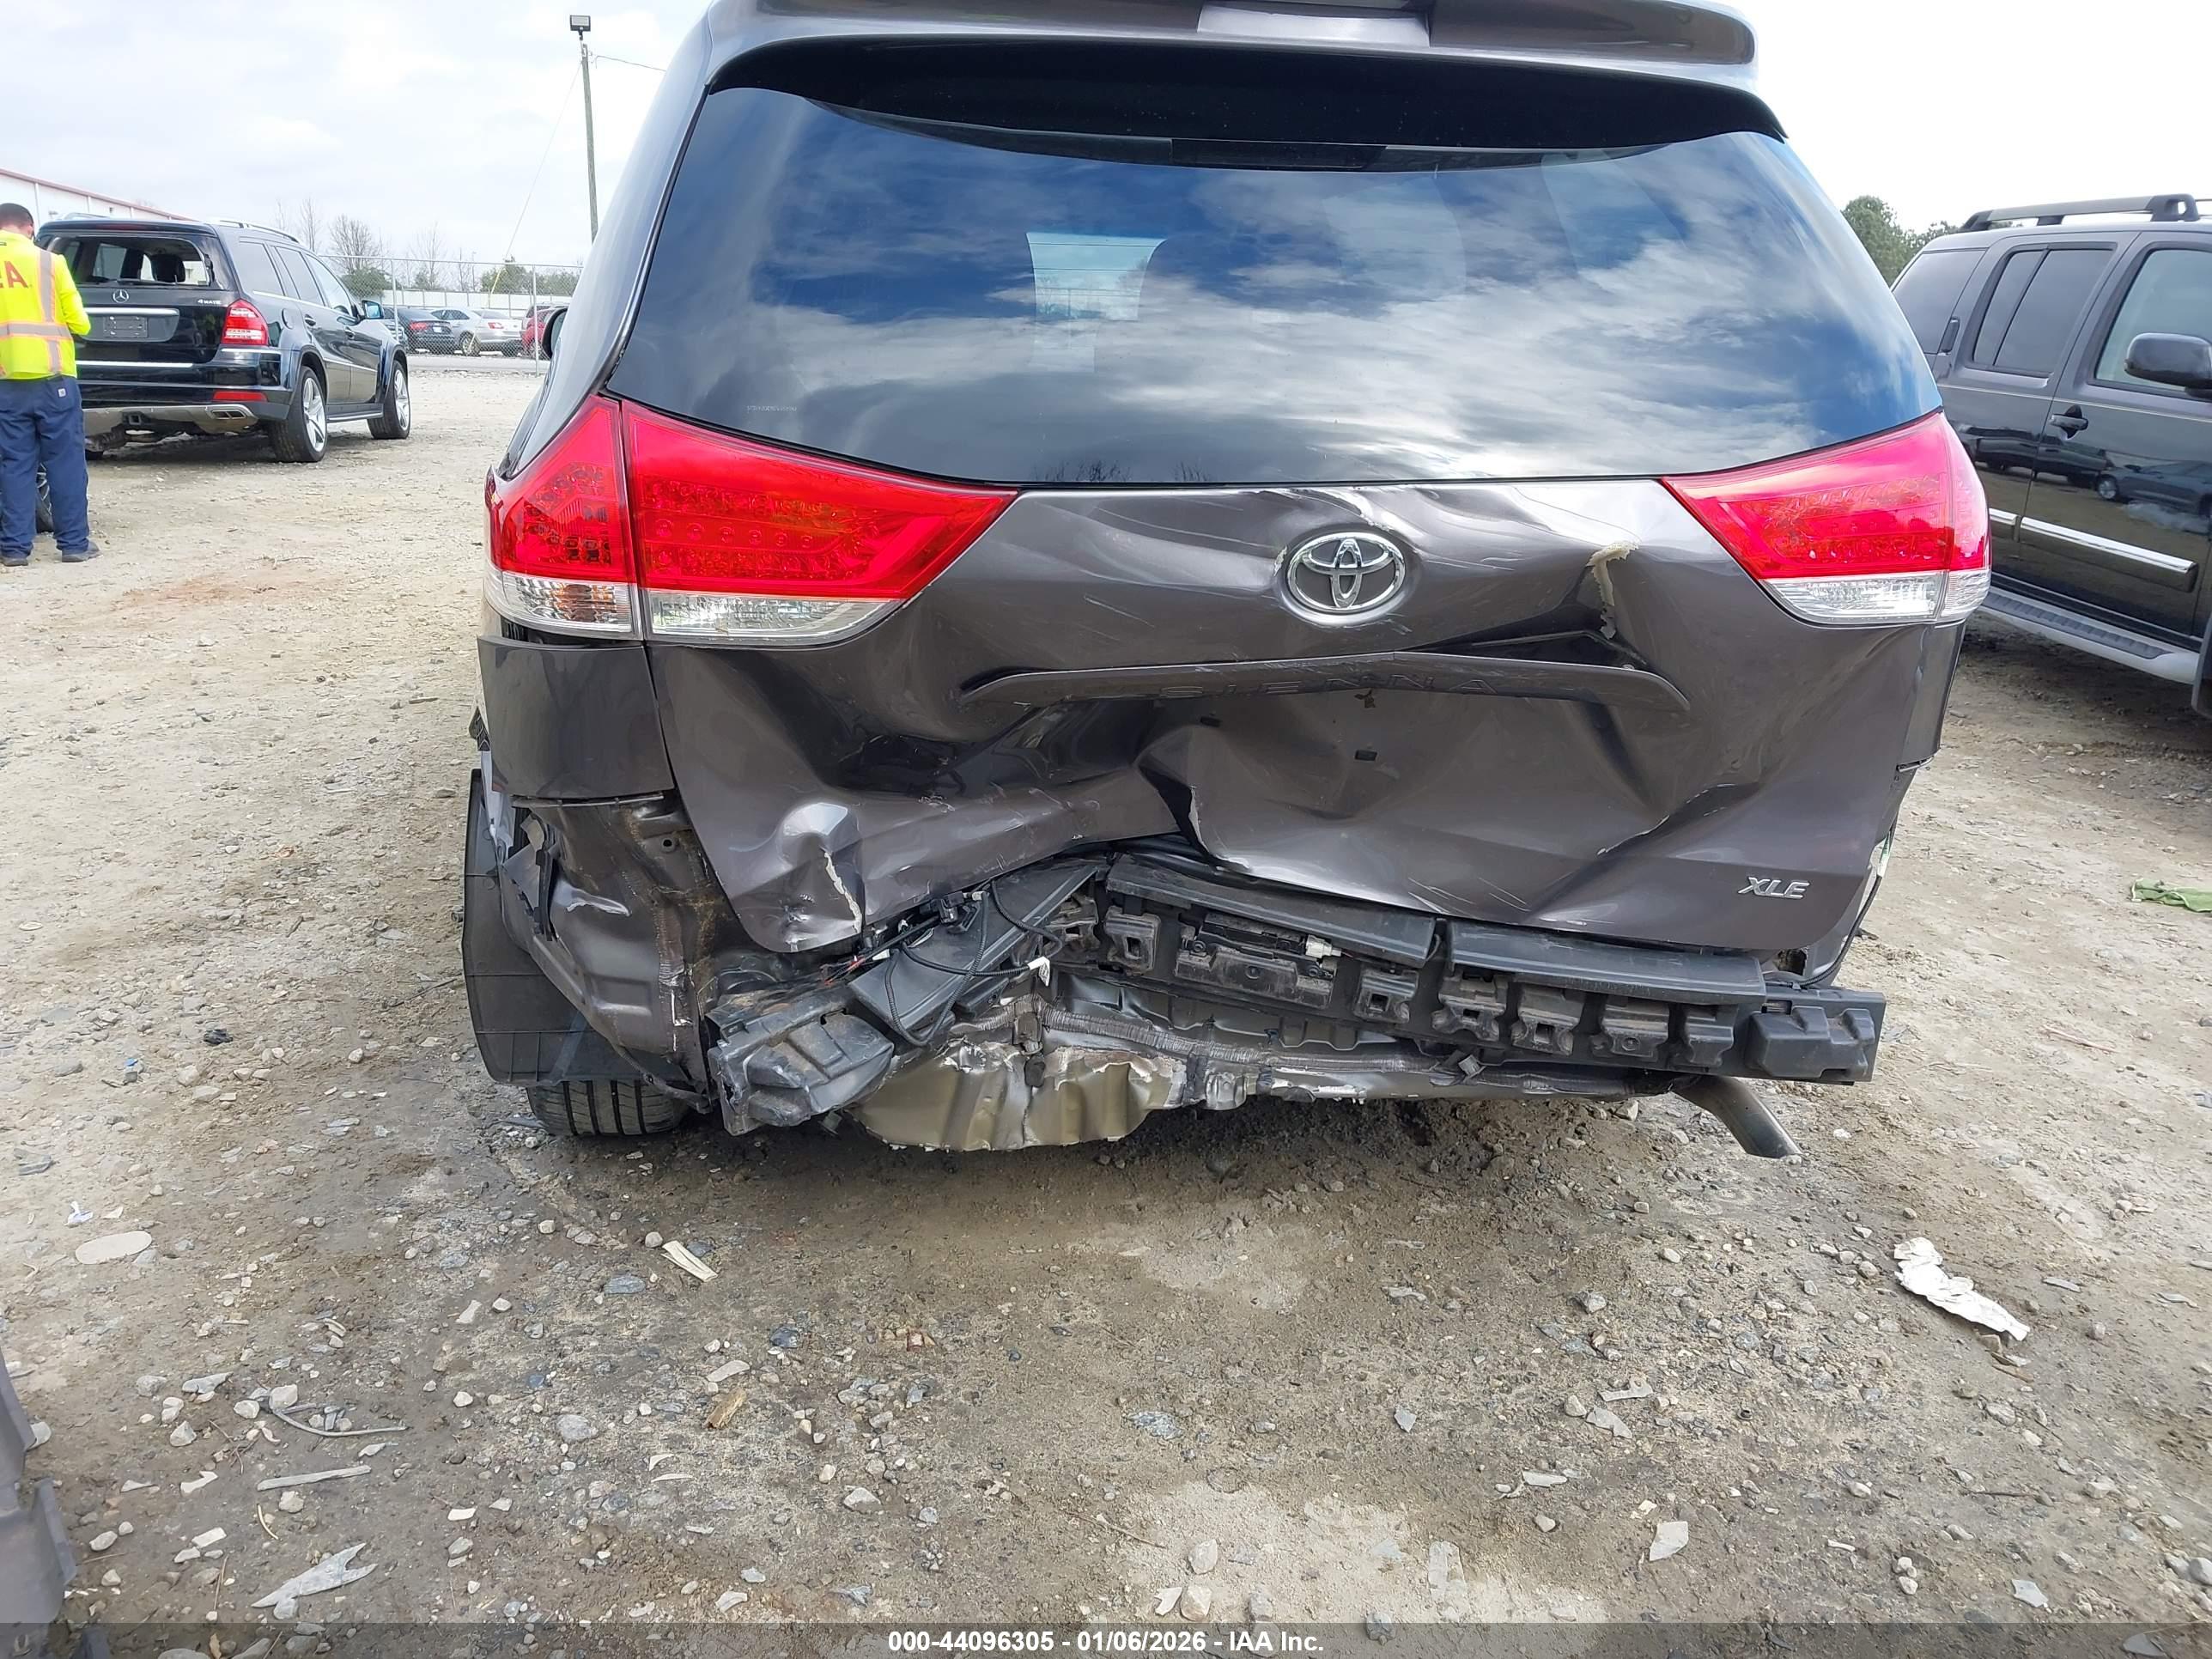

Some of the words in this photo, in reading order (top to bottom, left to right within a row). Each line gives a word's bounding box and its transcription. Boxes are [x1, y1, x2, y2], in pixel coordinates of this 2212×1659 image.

[0, 260, 28, 289] A
[1160, 674, 1498, 699] SIENNA
[1737, 876, 1810, 899] XLE
